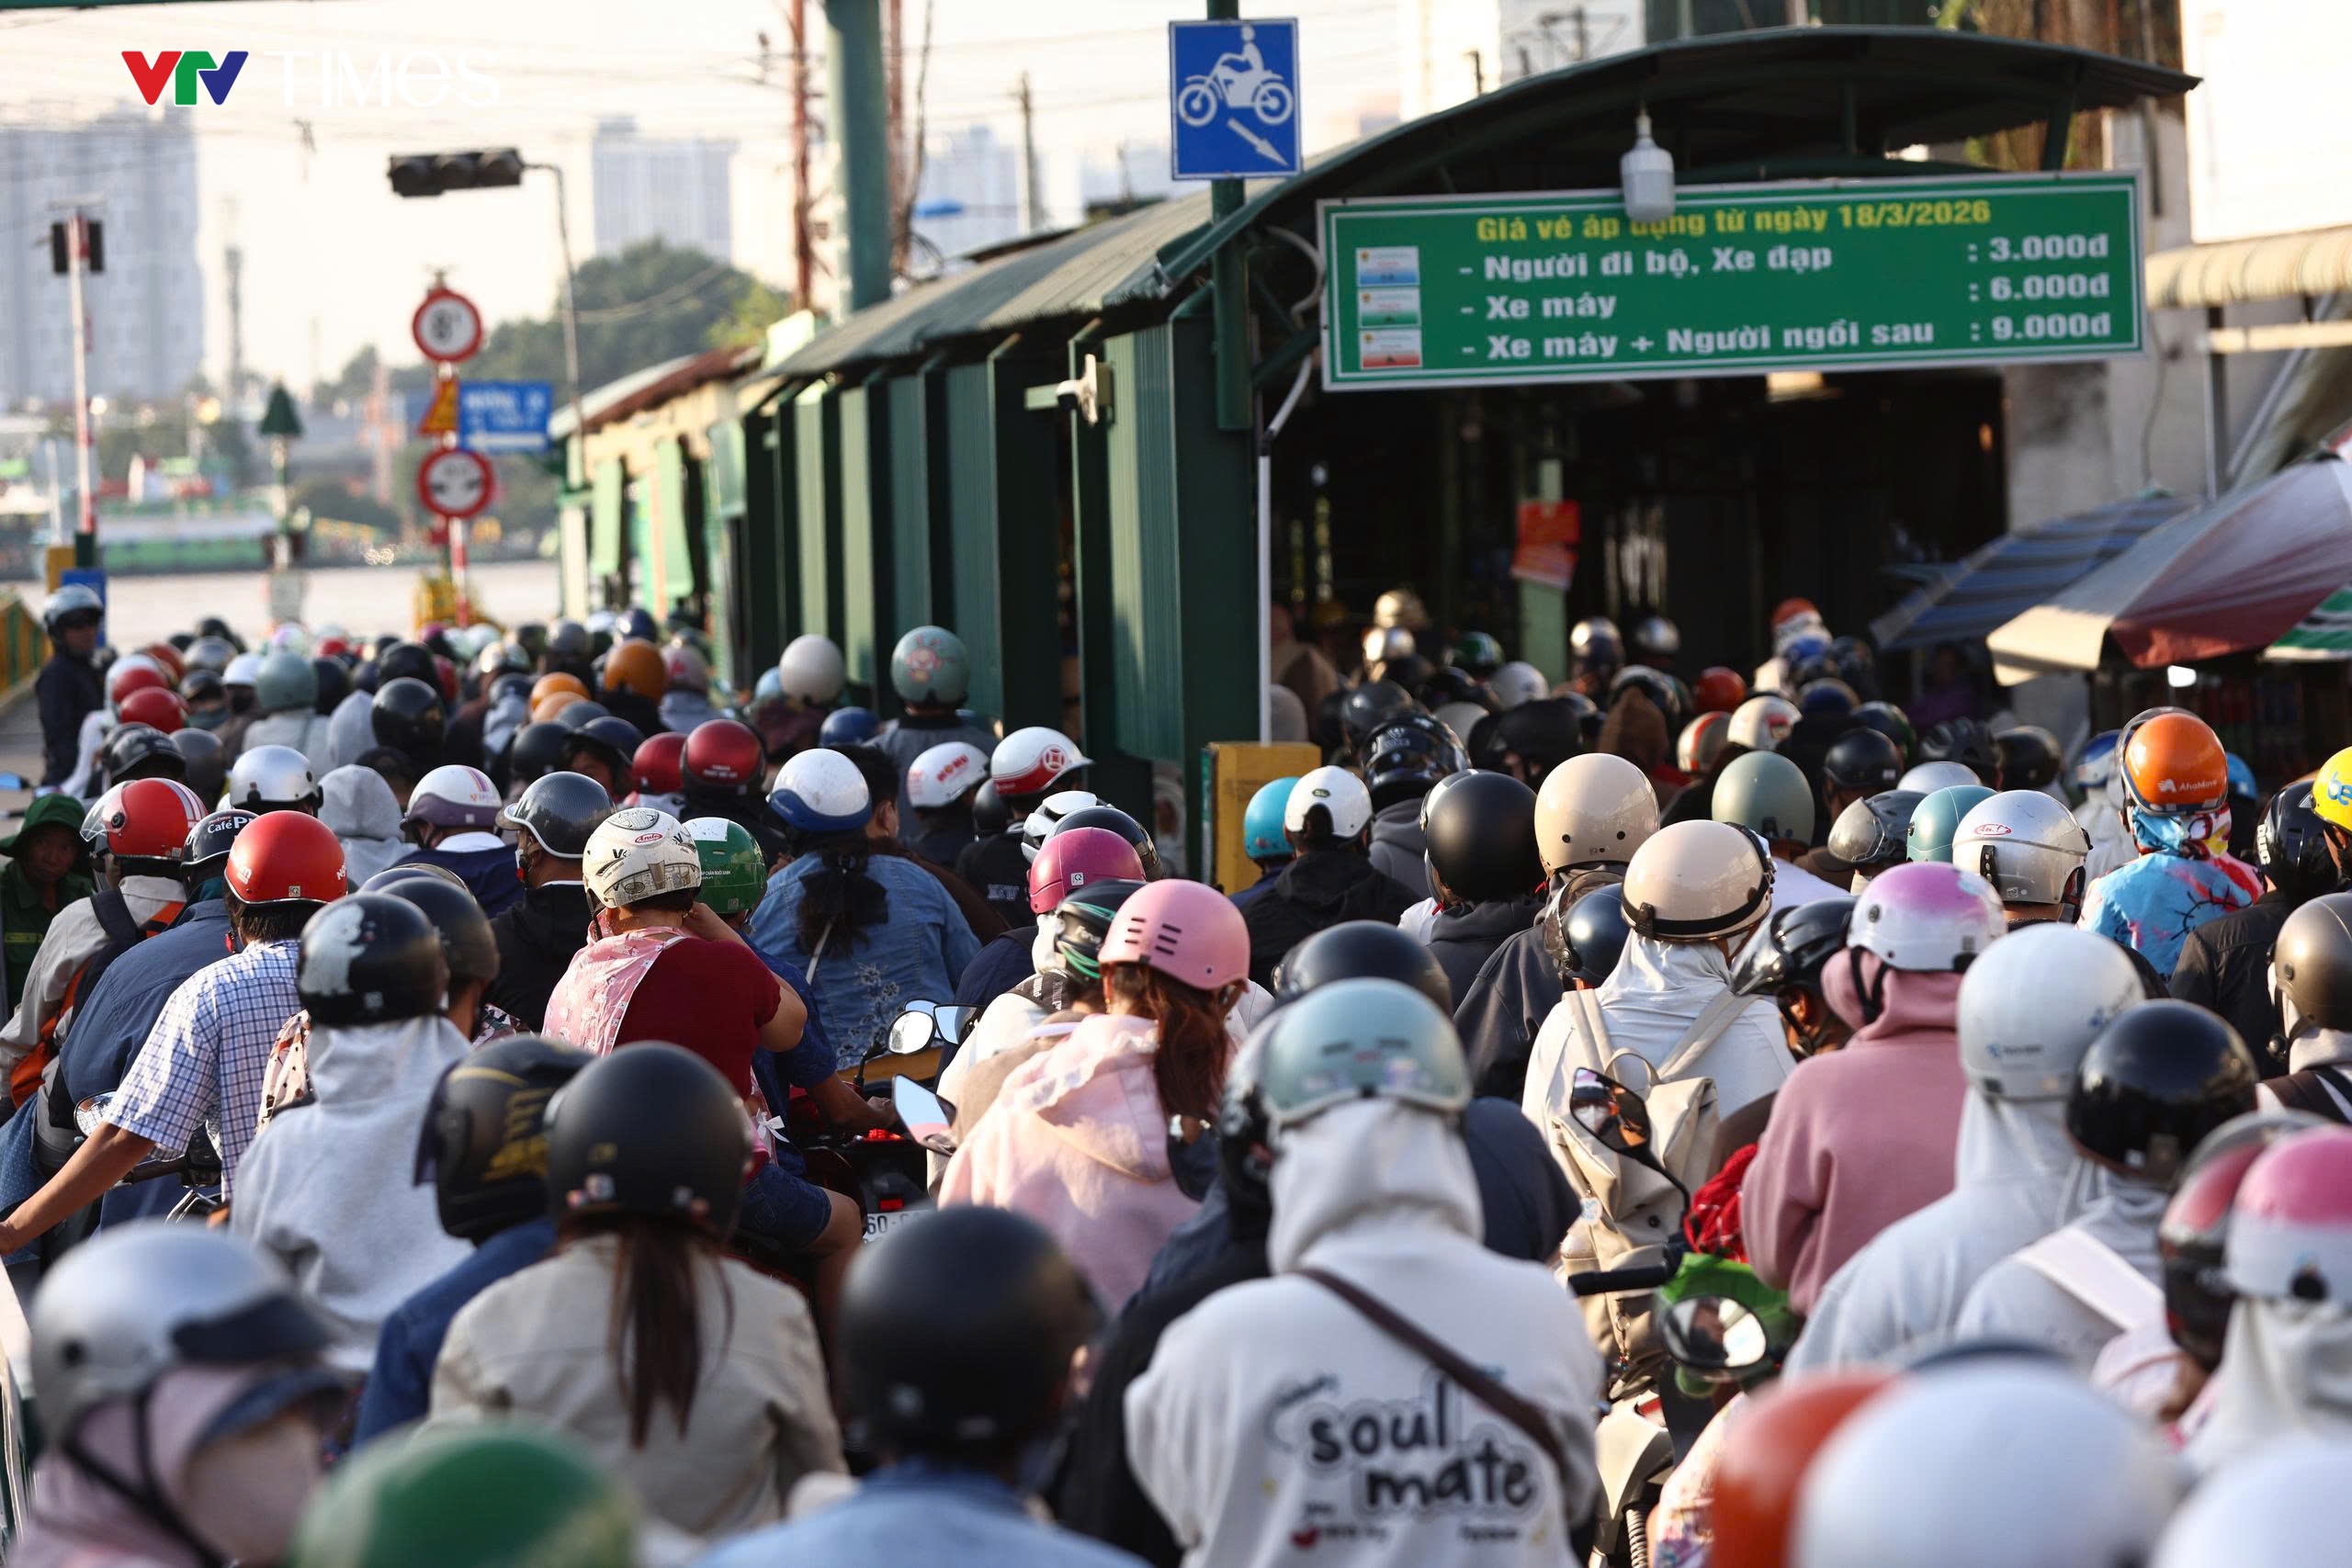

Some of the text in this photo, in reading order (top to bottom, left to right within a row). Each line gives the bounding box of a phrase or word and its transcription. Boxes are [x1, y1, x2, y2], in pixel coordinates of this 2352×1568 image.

[1476, 217, 1527, 242] Giá
[1536, 214, 1573, 240] vé
[1582, 213, 1620, 241] áp
[1714, 208, 1746, 233] từ
[1754, 205, 1828, 233] ngày
[1838, 199, 1991, 229] 18/3/2026
[1484, 252, 1588, 282] Người
[1600, 251, 1634, 276] đi
[1645, 248, 1700, 278] bộ,
[1712, 246, 1756, 272] Xe
[1767, 243, 1833, 275] đạp
[1989, 233, 2109, 263] 3.000đ
[1486, 295, 1531, 320] Xe
[1541, 290, 1617, 320] máy
[1990, 273, 2110, 301] 6.000đ
[1487, 334, 1532, 360] Xe
[1544, 331, 1619, 359] máy
[1667, 323, 1771, 355] Người
[1782, 318, 1860, 351] ngồi
[1871, 321, 1935, 346] sau
[1992, 311, 2111, 342] 9.000đ
[208, 819, 232, 834] Café
[1309, 1378, 1448, 1463] soul
[1366, 1439, 1537, 1507] mate
